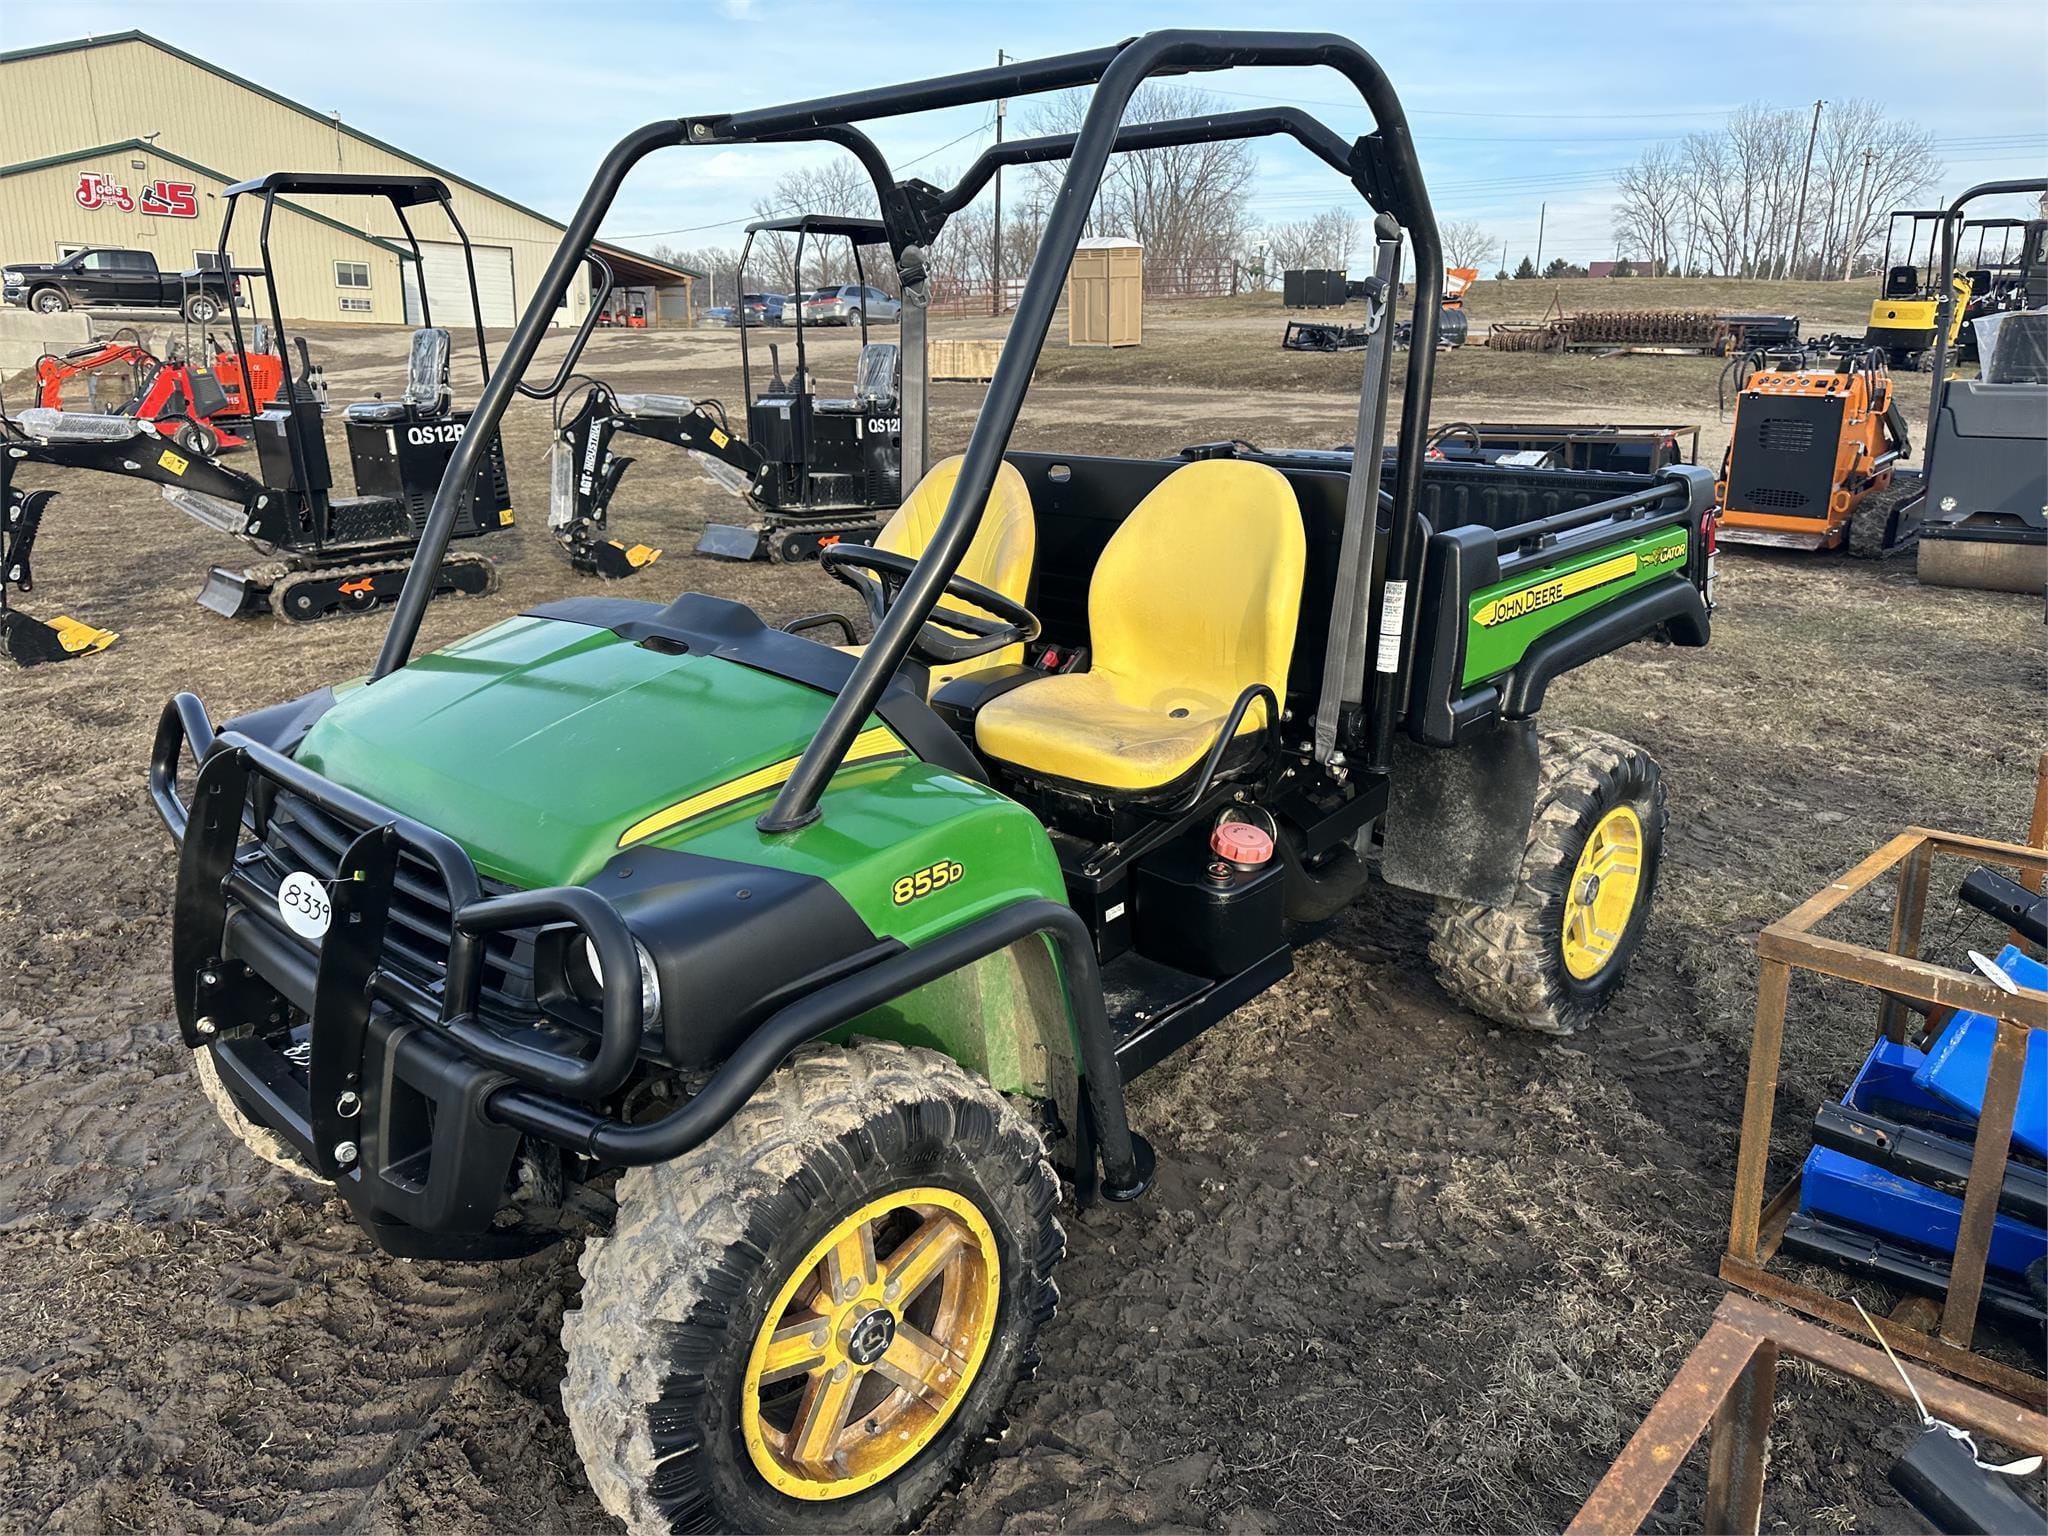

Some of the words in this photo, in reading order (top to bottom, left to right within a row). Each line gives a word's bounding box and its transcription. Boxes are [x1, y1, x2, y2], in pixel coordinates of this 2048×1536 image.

[1660, 543, 1686, 563] GATOR
[1489, 597, 1524, 623] JOHN
[1526, 583, 1563, 610] DEERE
[893, 861, 964, 904] 855D
[284, 884, 330, 925] 8339
